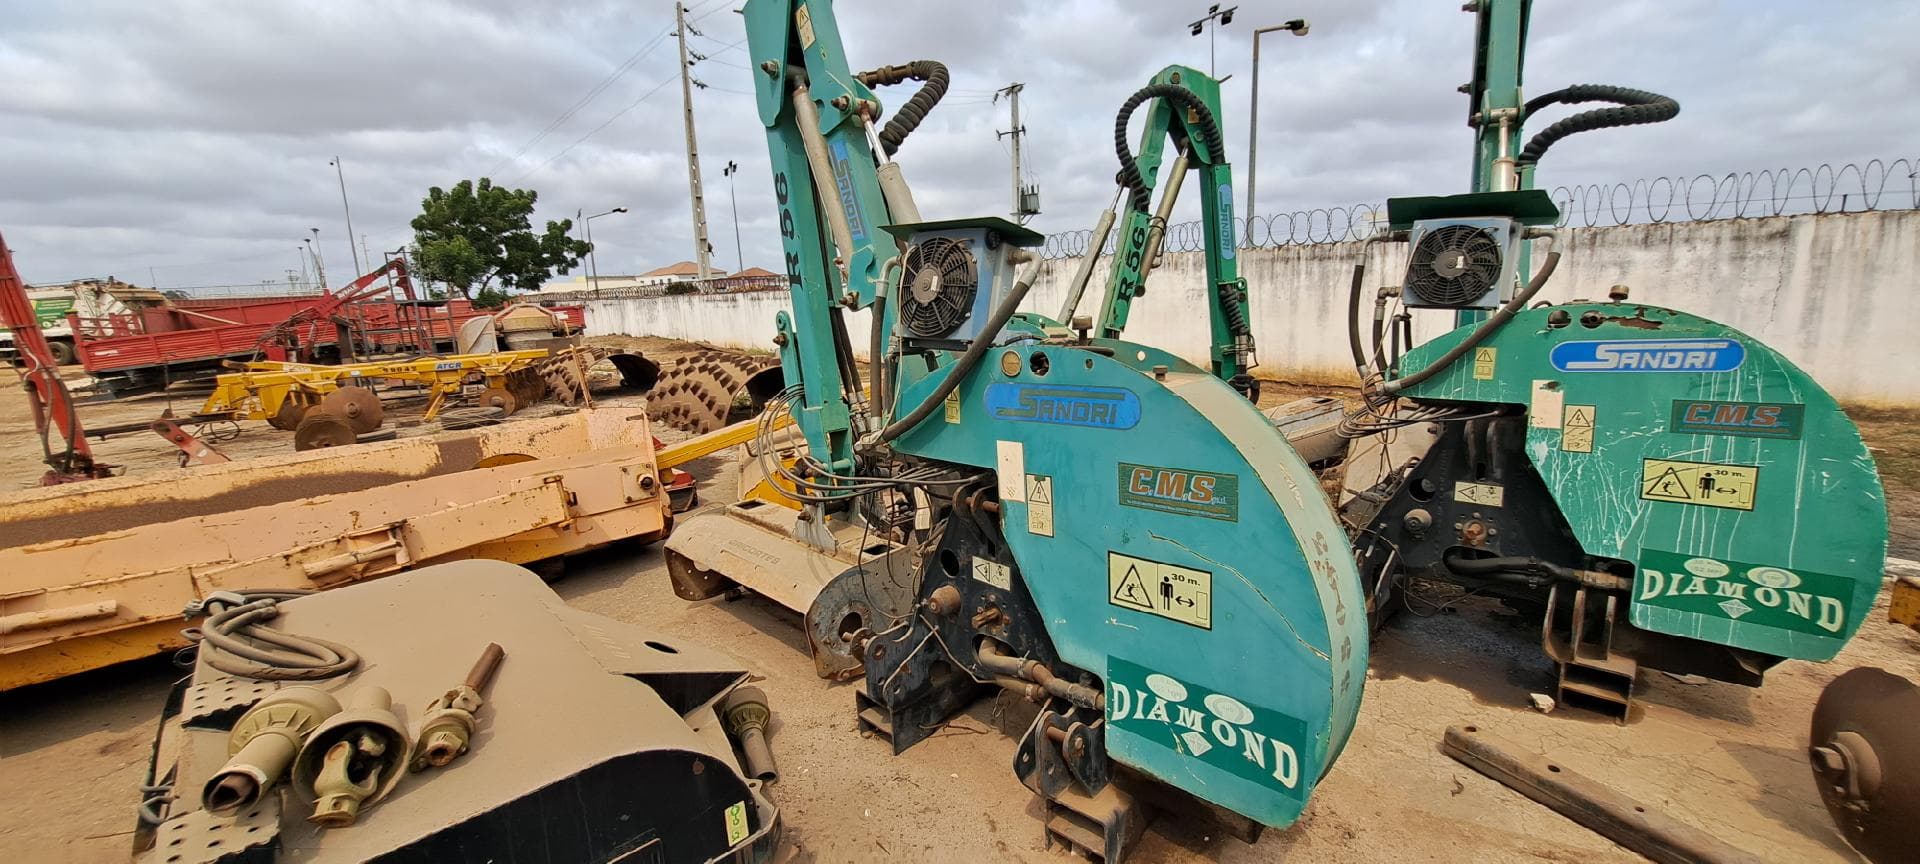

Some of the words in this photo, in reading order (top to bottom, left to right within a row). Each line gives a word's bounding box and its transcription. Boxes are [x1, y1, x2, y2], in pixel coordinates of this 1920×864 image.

[775, 171, 795, 240] 56
[828, 144, 867, 240] SANDRI
[1219, 190, 1235, 252] SANDRI
[786, 251, 804, 291] R
[1117, 277, 1135, 303] R
[1126, 227, 1146, 273] 56
[1565, 342, 1729, 369] SANDRI
[996, 388, 1126, 424] SANDRI
[1171, 573, 1186, 582] 30
[1187, 578, 1201, 587] m.
[1639, 568, 1845, 633] DIAMOND
[1110, 680, 1299, 790] DIAMOND
